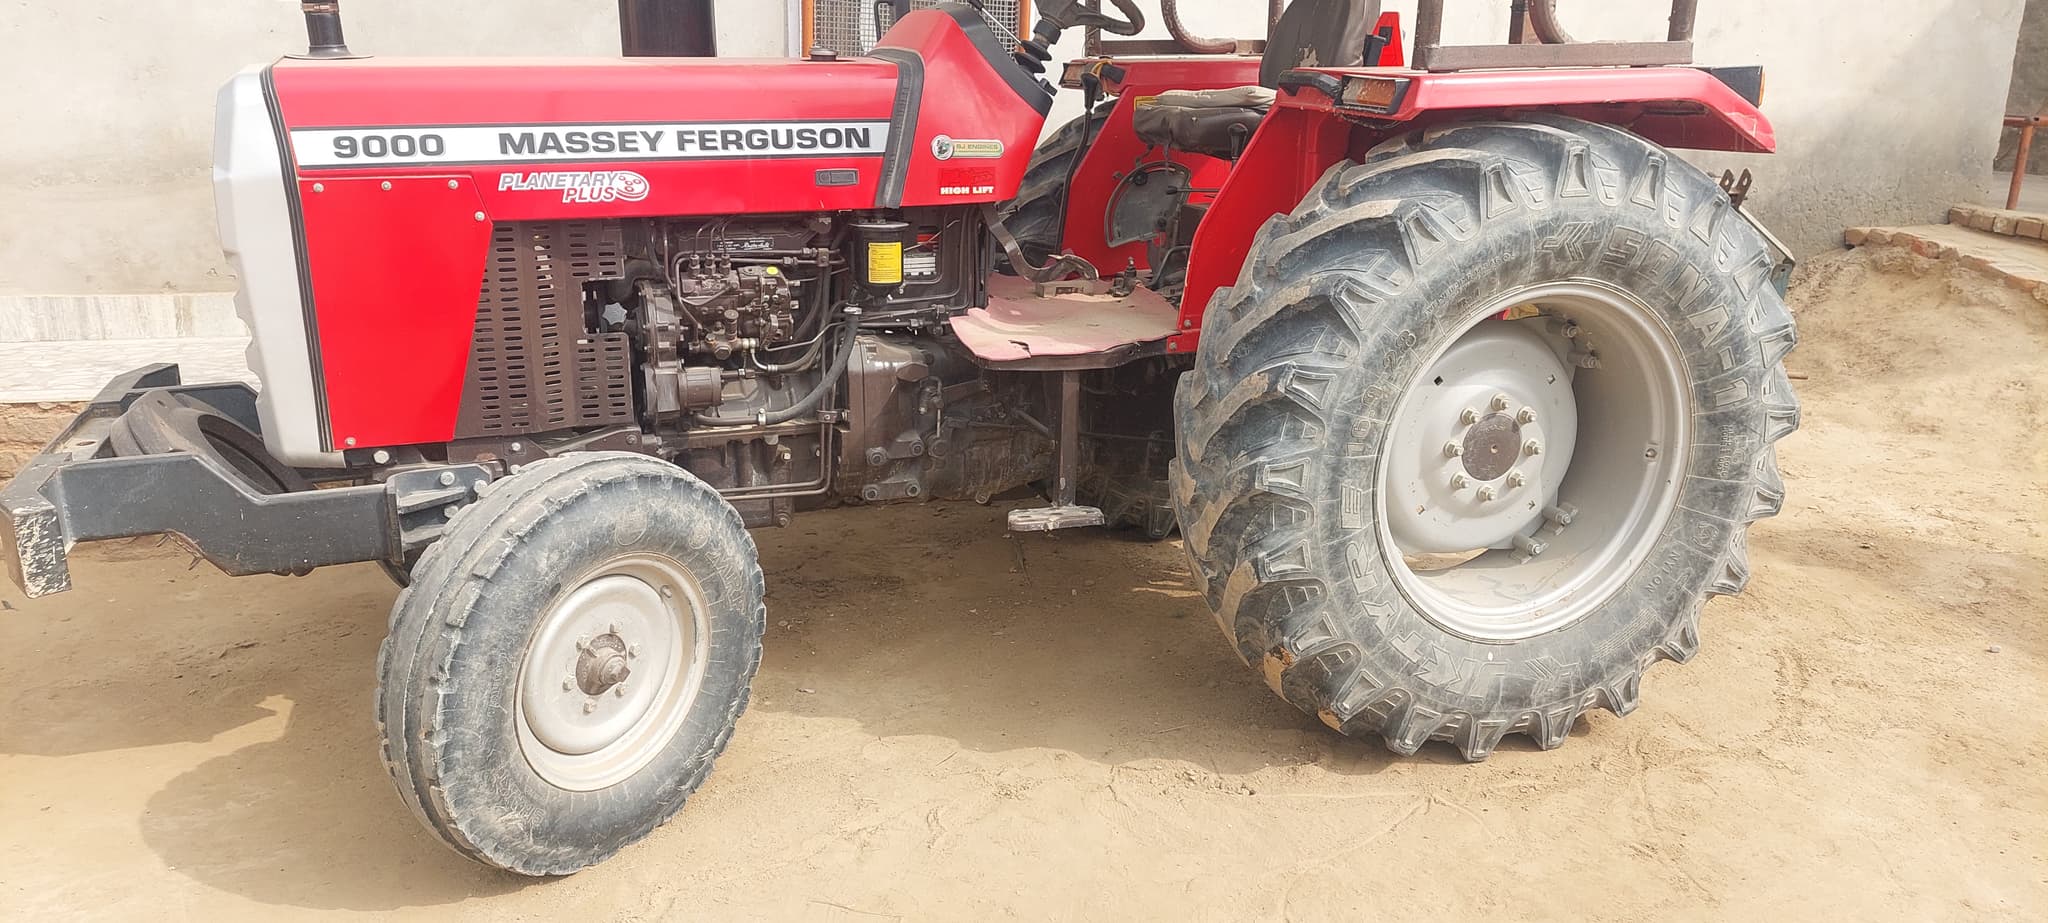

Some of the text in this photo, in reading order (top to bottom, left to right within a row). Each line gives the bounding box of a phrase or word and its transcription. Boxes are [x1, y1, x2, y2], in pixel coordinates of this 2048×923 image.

[333, 127, 871, 159] 9000 MASSEY FERGUSON
[498, 171, 619, 190] PLANETARY
[940, 185, 994, 195] HIGH LIFT
[563, 186, 615, 202] PLUS
[1600, 226, 1748, 408] SONA-1
